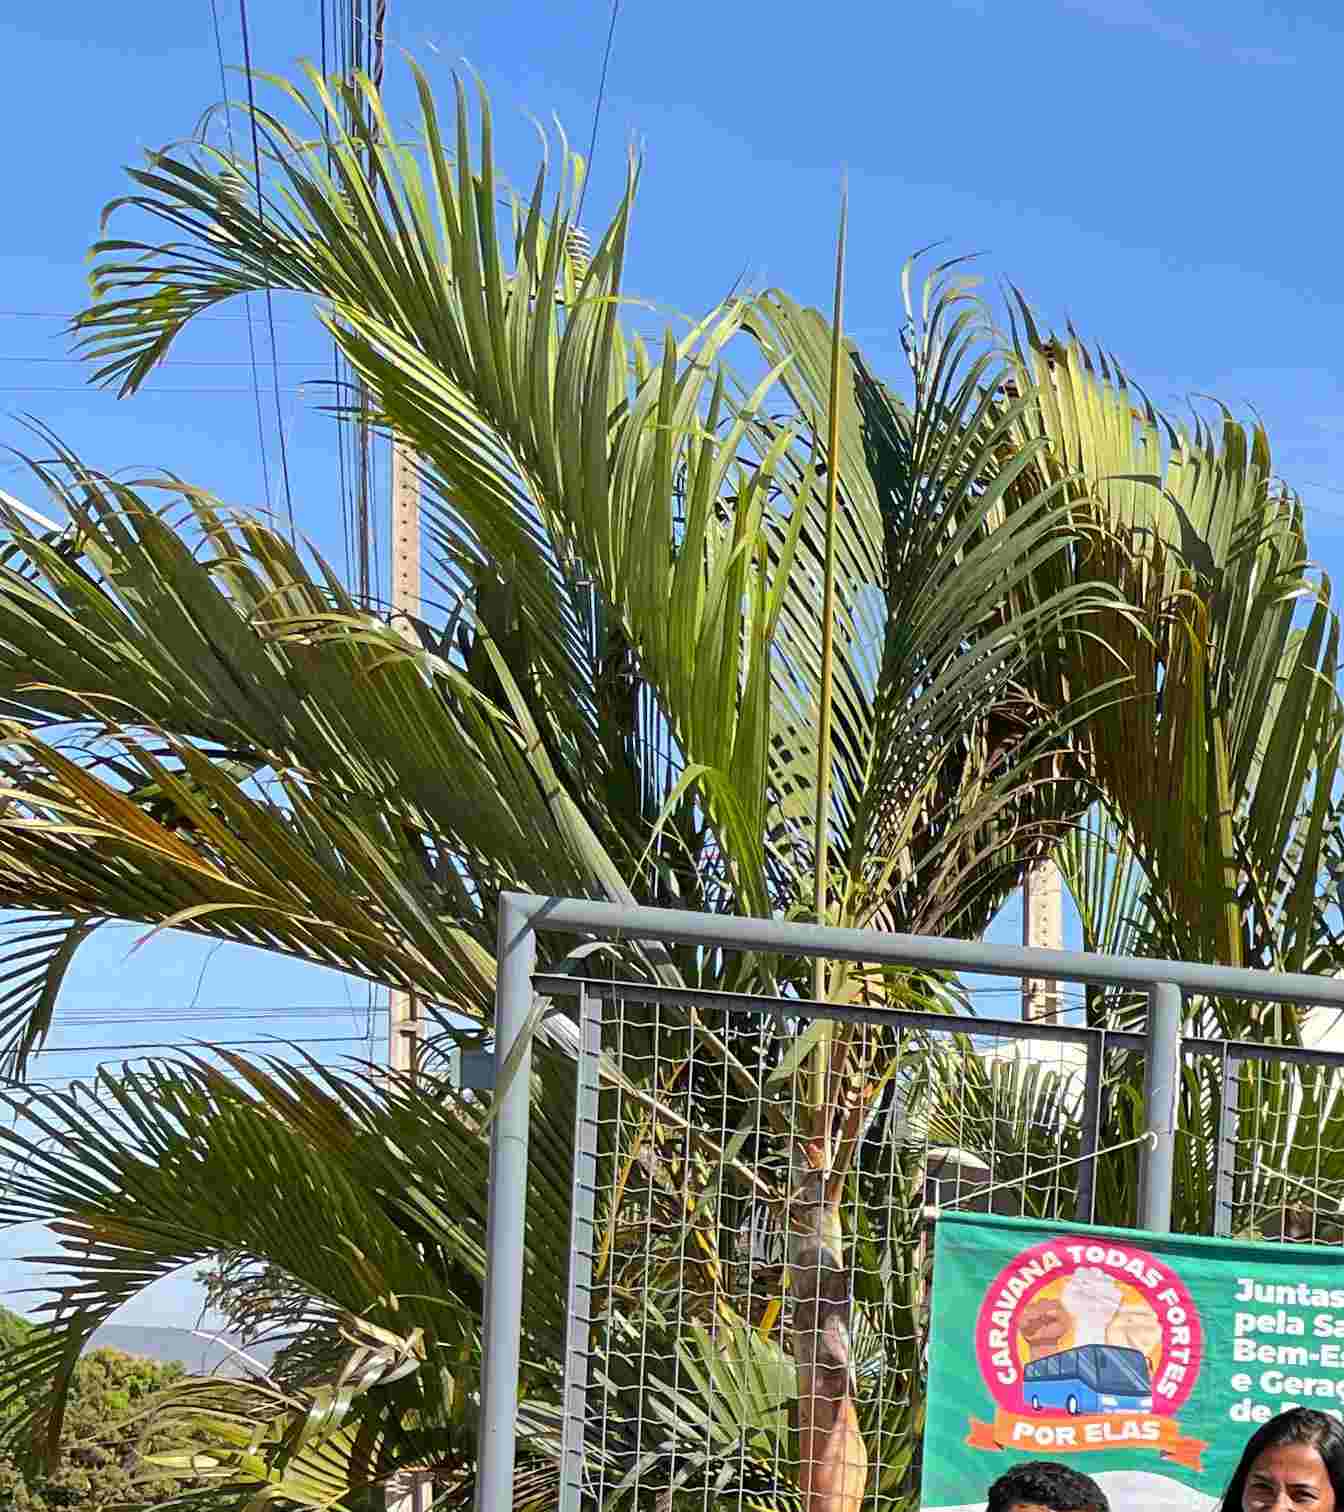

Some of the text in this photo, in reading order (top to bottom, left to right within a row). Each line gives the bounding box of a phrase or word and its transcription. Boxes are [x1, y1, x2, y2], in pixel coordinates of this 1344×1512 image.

[988, 1246, 1191, 1399] CARAVANA TODAS FORTES
[1234, 1310, 1305, 1337] pela
[1231, 1373, 1252, 1392] e
[1229, 1398, 1273, 1424] de
[1012, 1421, 1161, 1446] POR ELAS
